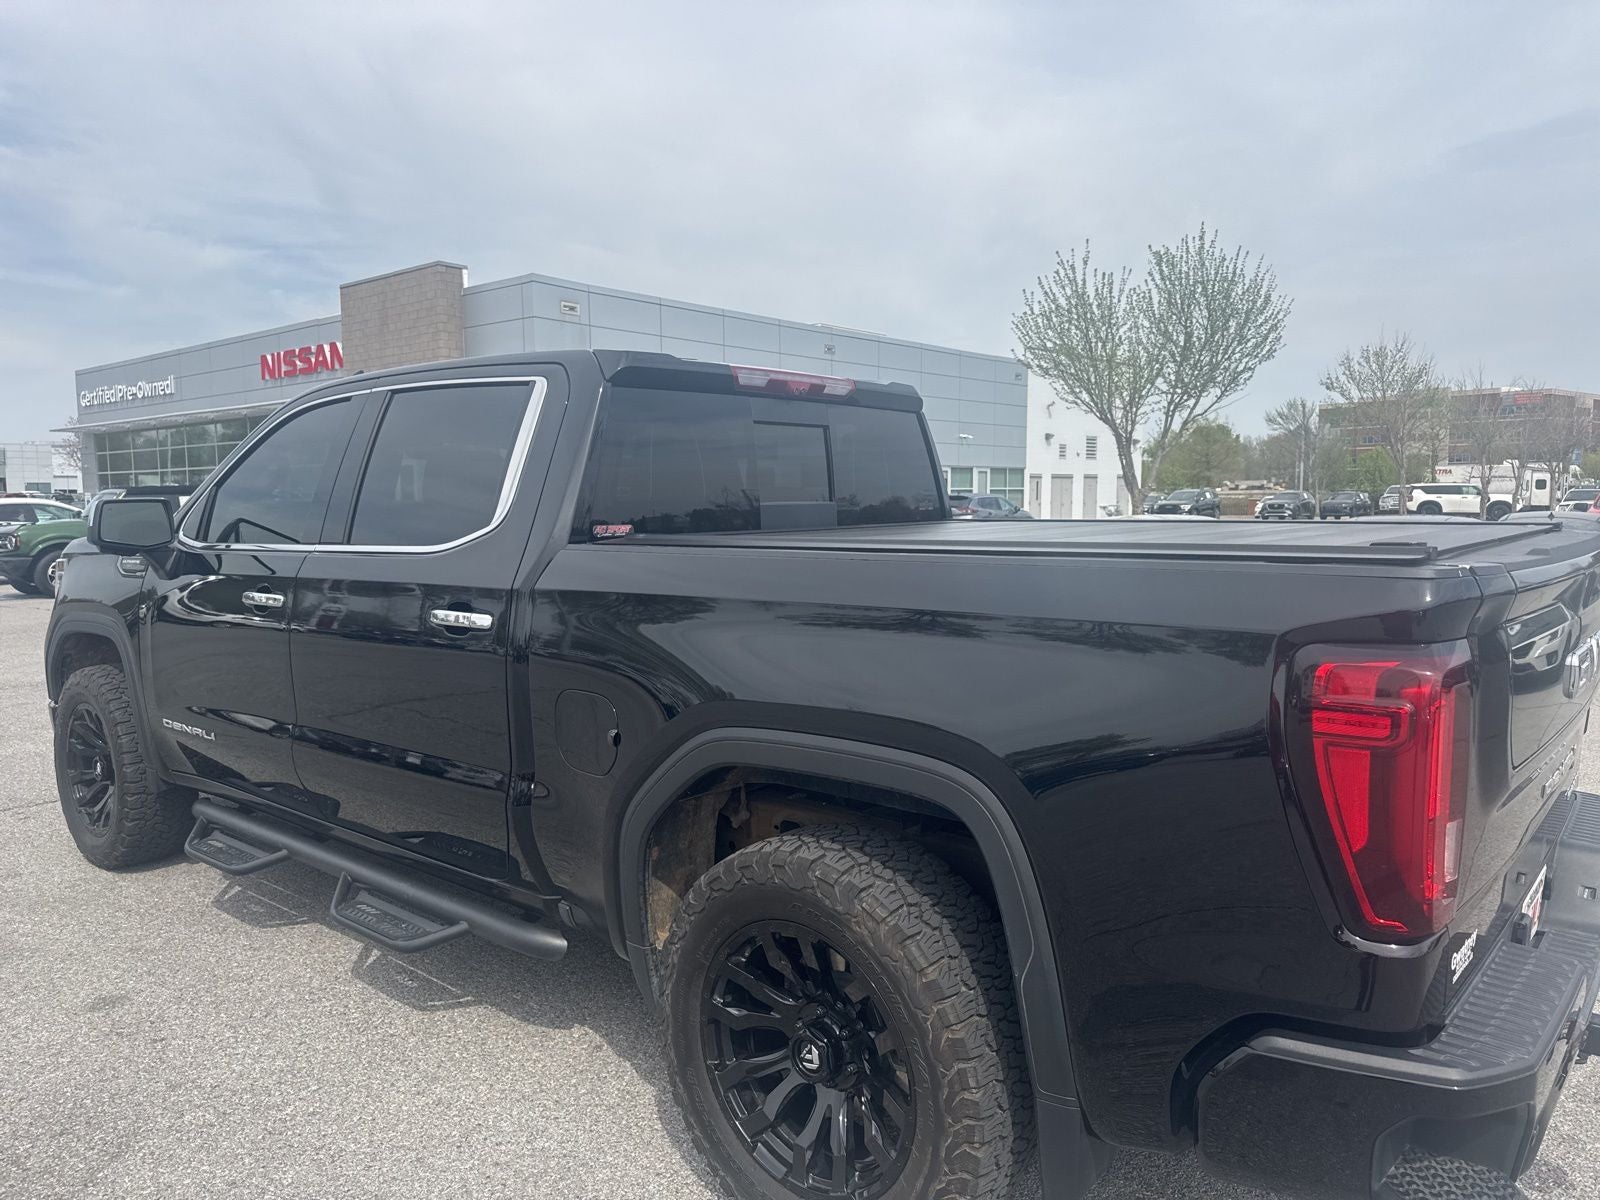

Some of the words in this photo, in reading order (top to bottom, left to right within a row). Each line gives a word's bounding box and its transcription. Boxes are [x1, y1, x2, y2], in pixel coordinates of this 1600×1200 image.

[261, 341, 344, 380] NISSAN
[80, 385, 117, 407] Certified
[117, 374, 175, 402] Pre-Owned
[162, 718, 216, 741] DENALI
